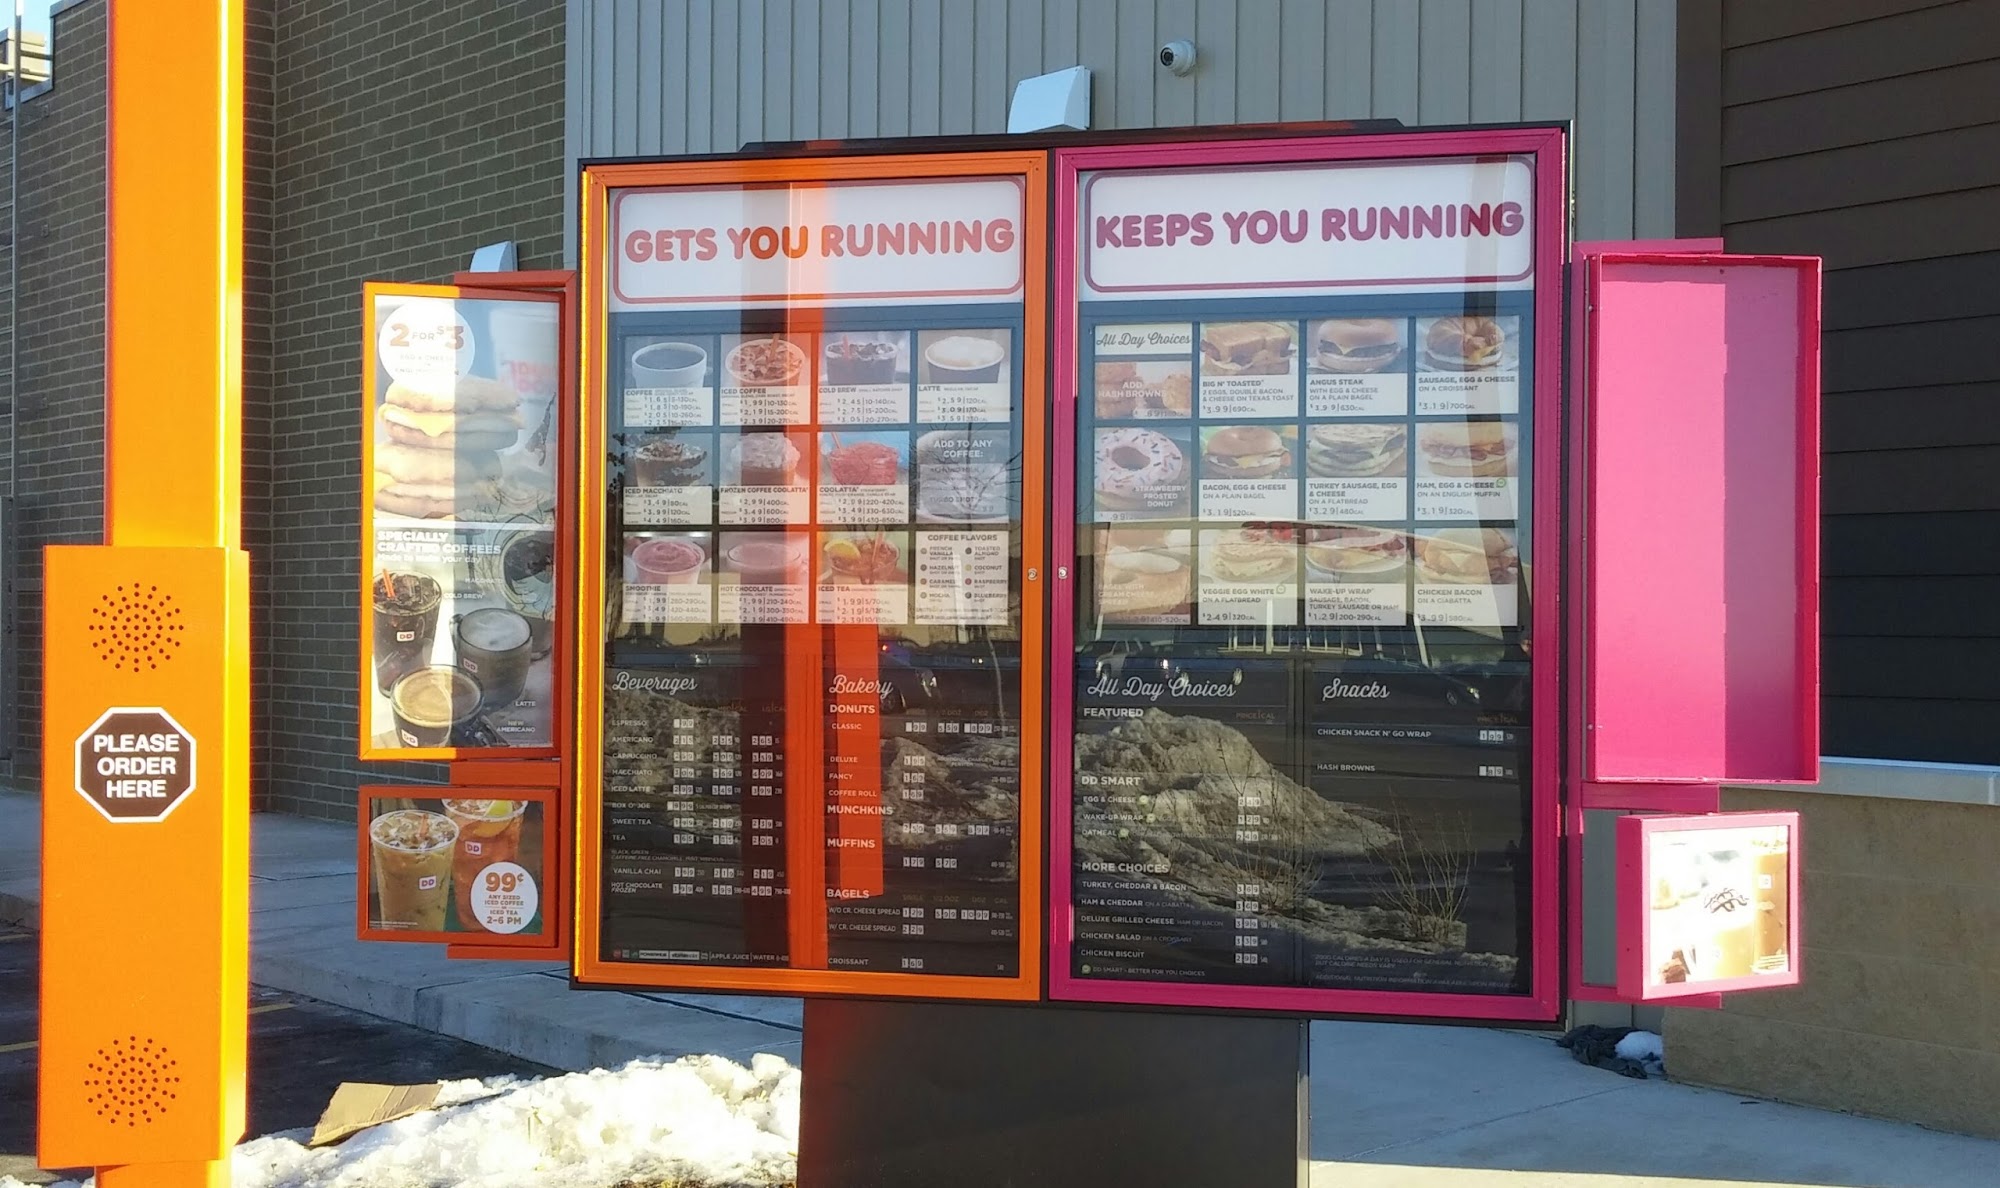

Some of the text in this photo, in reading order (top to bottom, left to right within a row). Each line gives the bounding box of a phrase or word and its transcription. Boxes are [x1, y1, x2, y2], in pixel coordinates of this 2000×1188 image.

[1096, 202, 1524, 248] KEEPS YOU RUNNING
[625, 219, 1015, 263] GETS YOU RUNNING
[1097, 332, 1190, 348] All Day Choices
[934, 440, 992, 448] ADD TO ANY
[377, 531, 448, 541] SPECIALLY
[377, 544, 501, 554] CRAFTED COFFEES
[612, 671, 697, 695] Beverages
[829, 675, 893, 699] Bakery
[1088, 677, 1236, 701] All Day Choices
[1322, 678, 1390, 701] Snacks
[830, 705, 875, 713] DONUTS
[1084, 708, 1143, 718] FEATURED
[94, 734, 180, 752] PLEASE
[97, 757, 176, 776] ORDER
[1082, 777, 1141, 785] DD SMART
[106, 780, 166, 798] HERE
[827, 805, 893, 814] MUNCHKINS
[467, 844, 479, 852] DD
[827, 839, 875, 848] MUFFINS
[1082, 863, 1169, 873] MORE CHOICES
[422, 879, 434, 887] DD
[485, 872, 524, 892] 99¢
[827, 889, 869, 898] BAGELS
